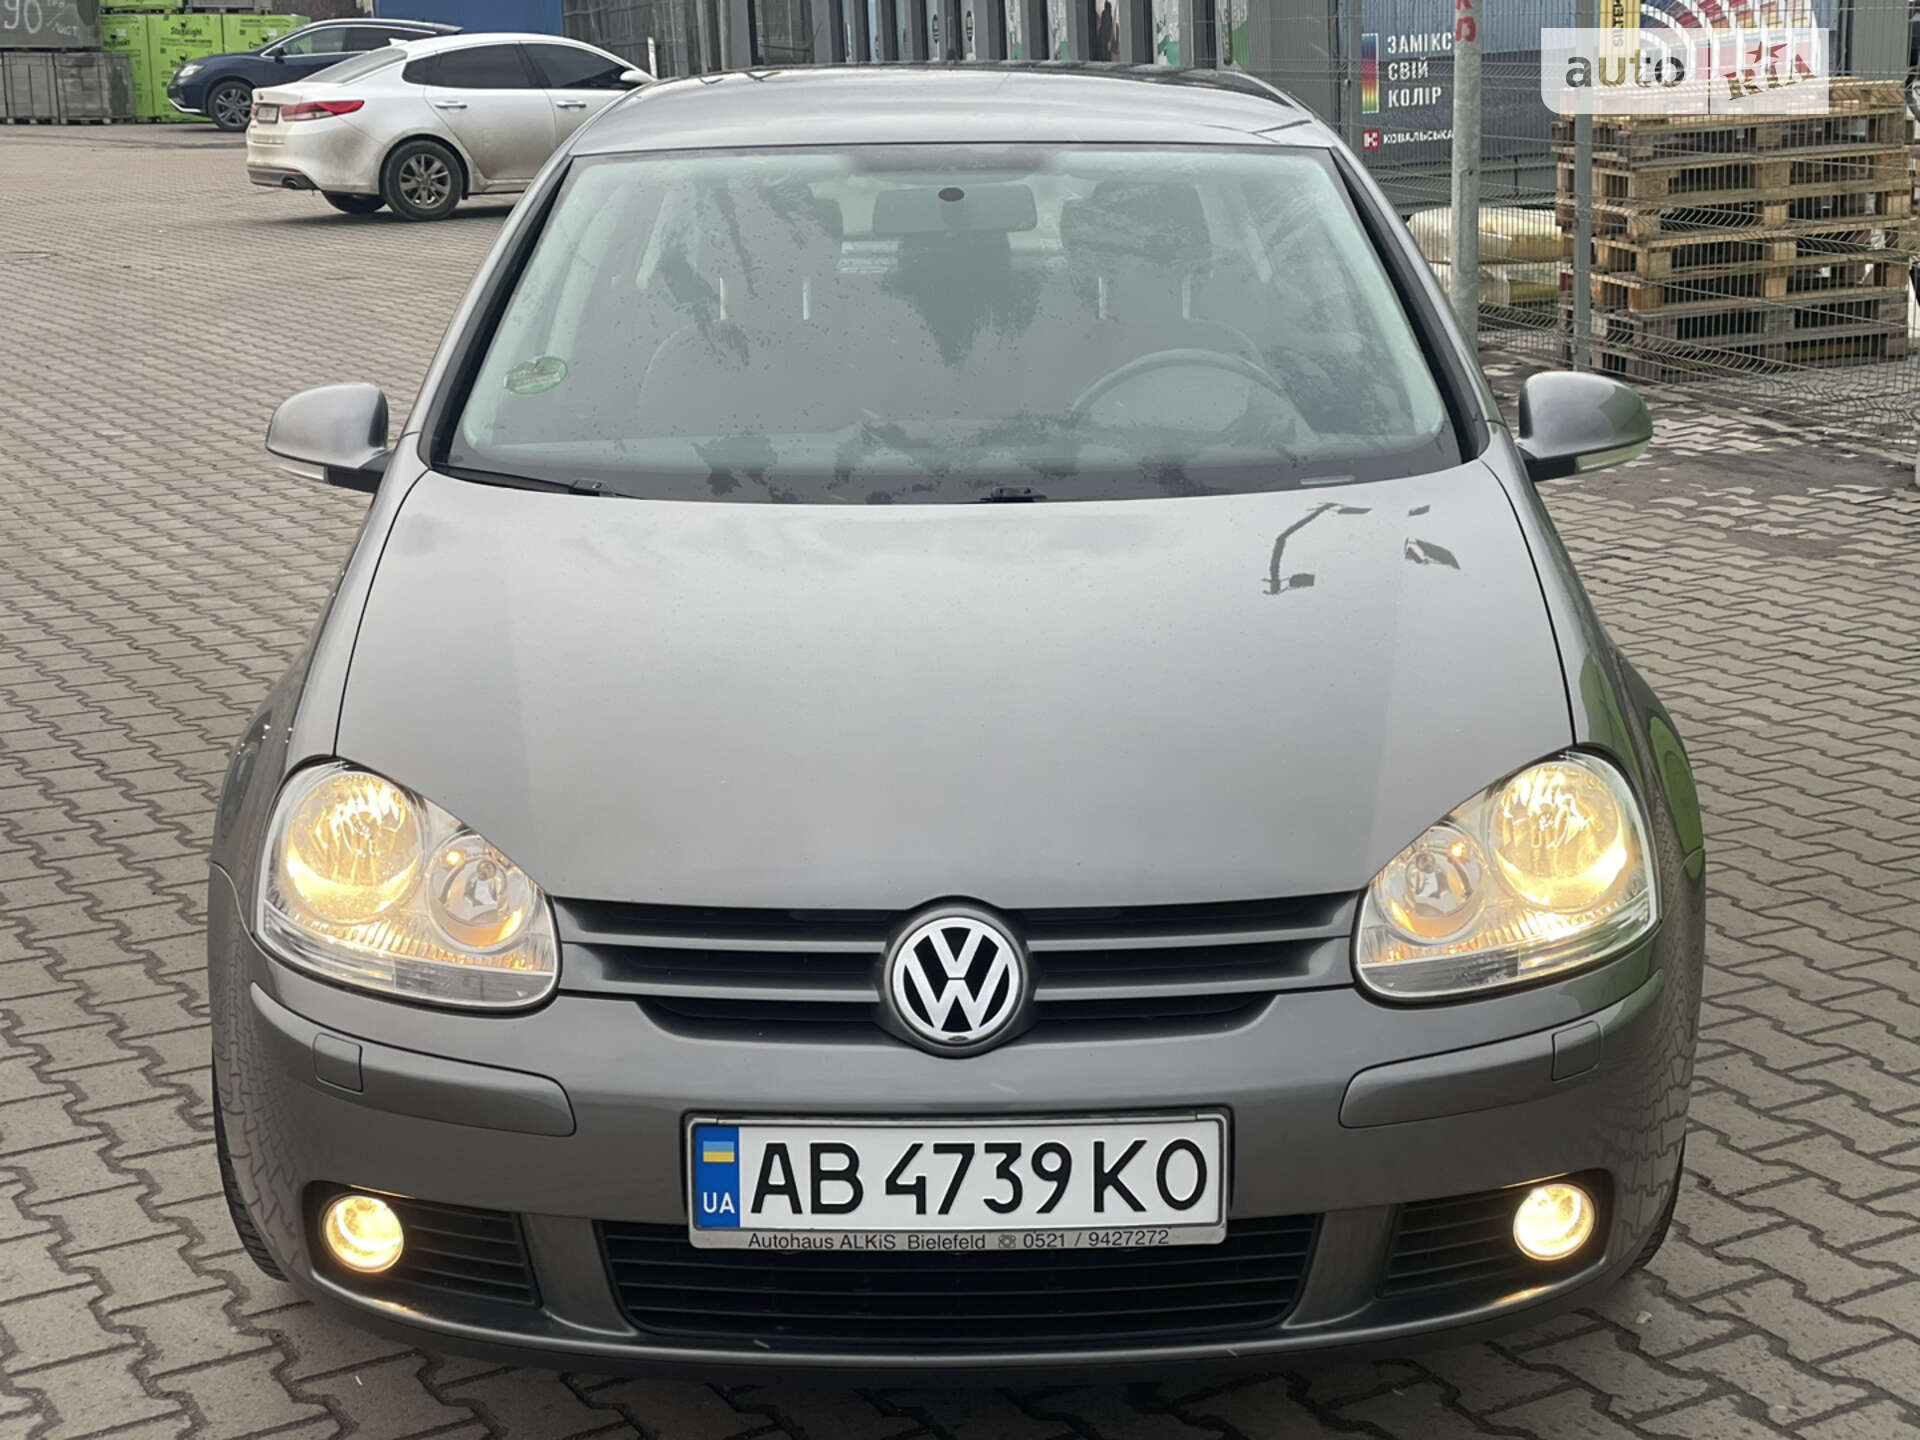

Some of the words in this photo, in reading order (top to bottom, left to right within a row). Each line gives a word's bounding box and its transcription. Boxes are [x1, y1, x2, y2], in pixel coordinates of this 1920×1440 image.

[1387, 32, 1455, 54] ЗАМІКС
[1388, 57, 1429, 80] СВІЙ
[1388, 86, 1442, 108] КОЛІР
[750, 1142, 864, 1215] AB
[885, 1142, 1073, 1215] 4739
[1093, 1138, 1208, 1213] KO
[703, 1193, 736, 1214] UA
[748, 1232, 835, 1249] Autohaus
[839, 1233, 897, 1250] ALKiS
[907, 1233, 986, 1250] Bielefeld
[1023, 1232, 1066, 1249] 0521
[1088, 1229, 1170, 1248] 9427272
